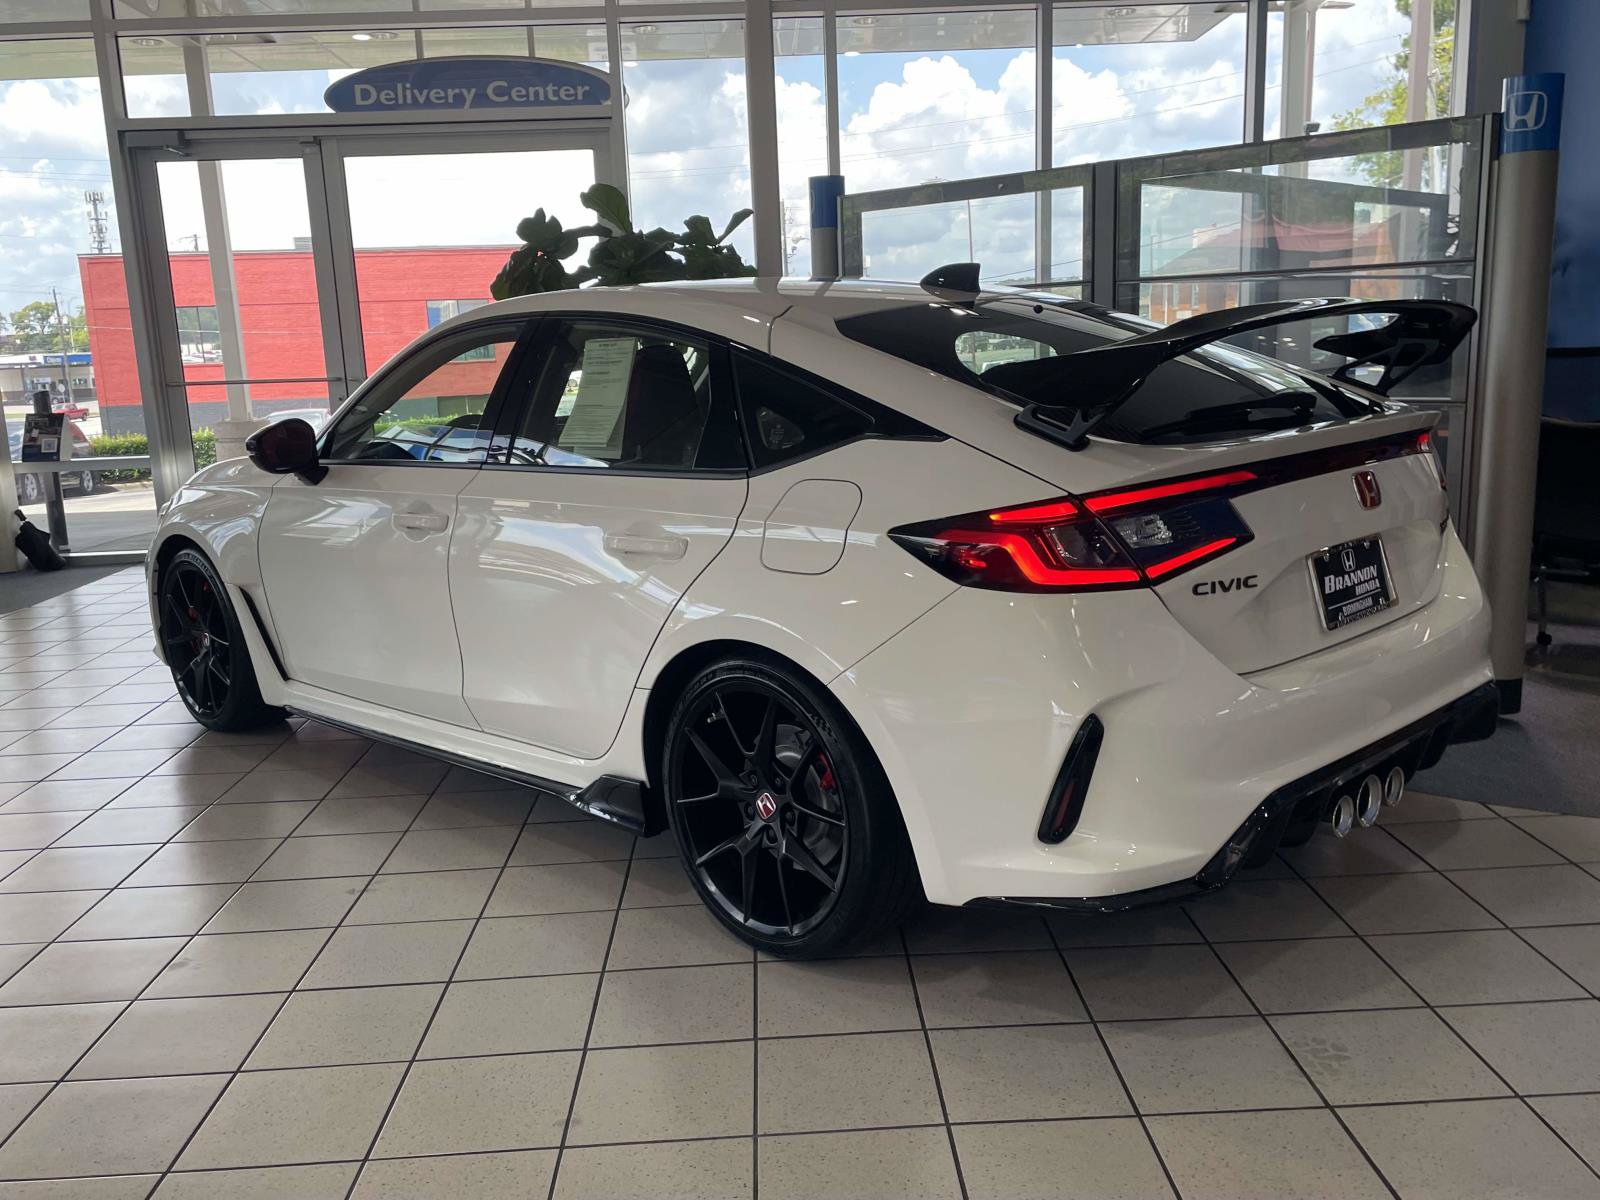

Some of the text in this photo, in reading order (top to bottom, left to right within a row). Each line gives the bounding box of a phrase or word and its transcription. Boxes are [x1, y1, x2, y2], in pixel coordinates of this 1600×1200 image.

[353, 80, 590, 110] Delivery Center
[1191, 574, 1258, 596] CIVIC
[1324, 565, 1378, 594] BRANNON
[1355, 578, 1380, 596] HONDA
